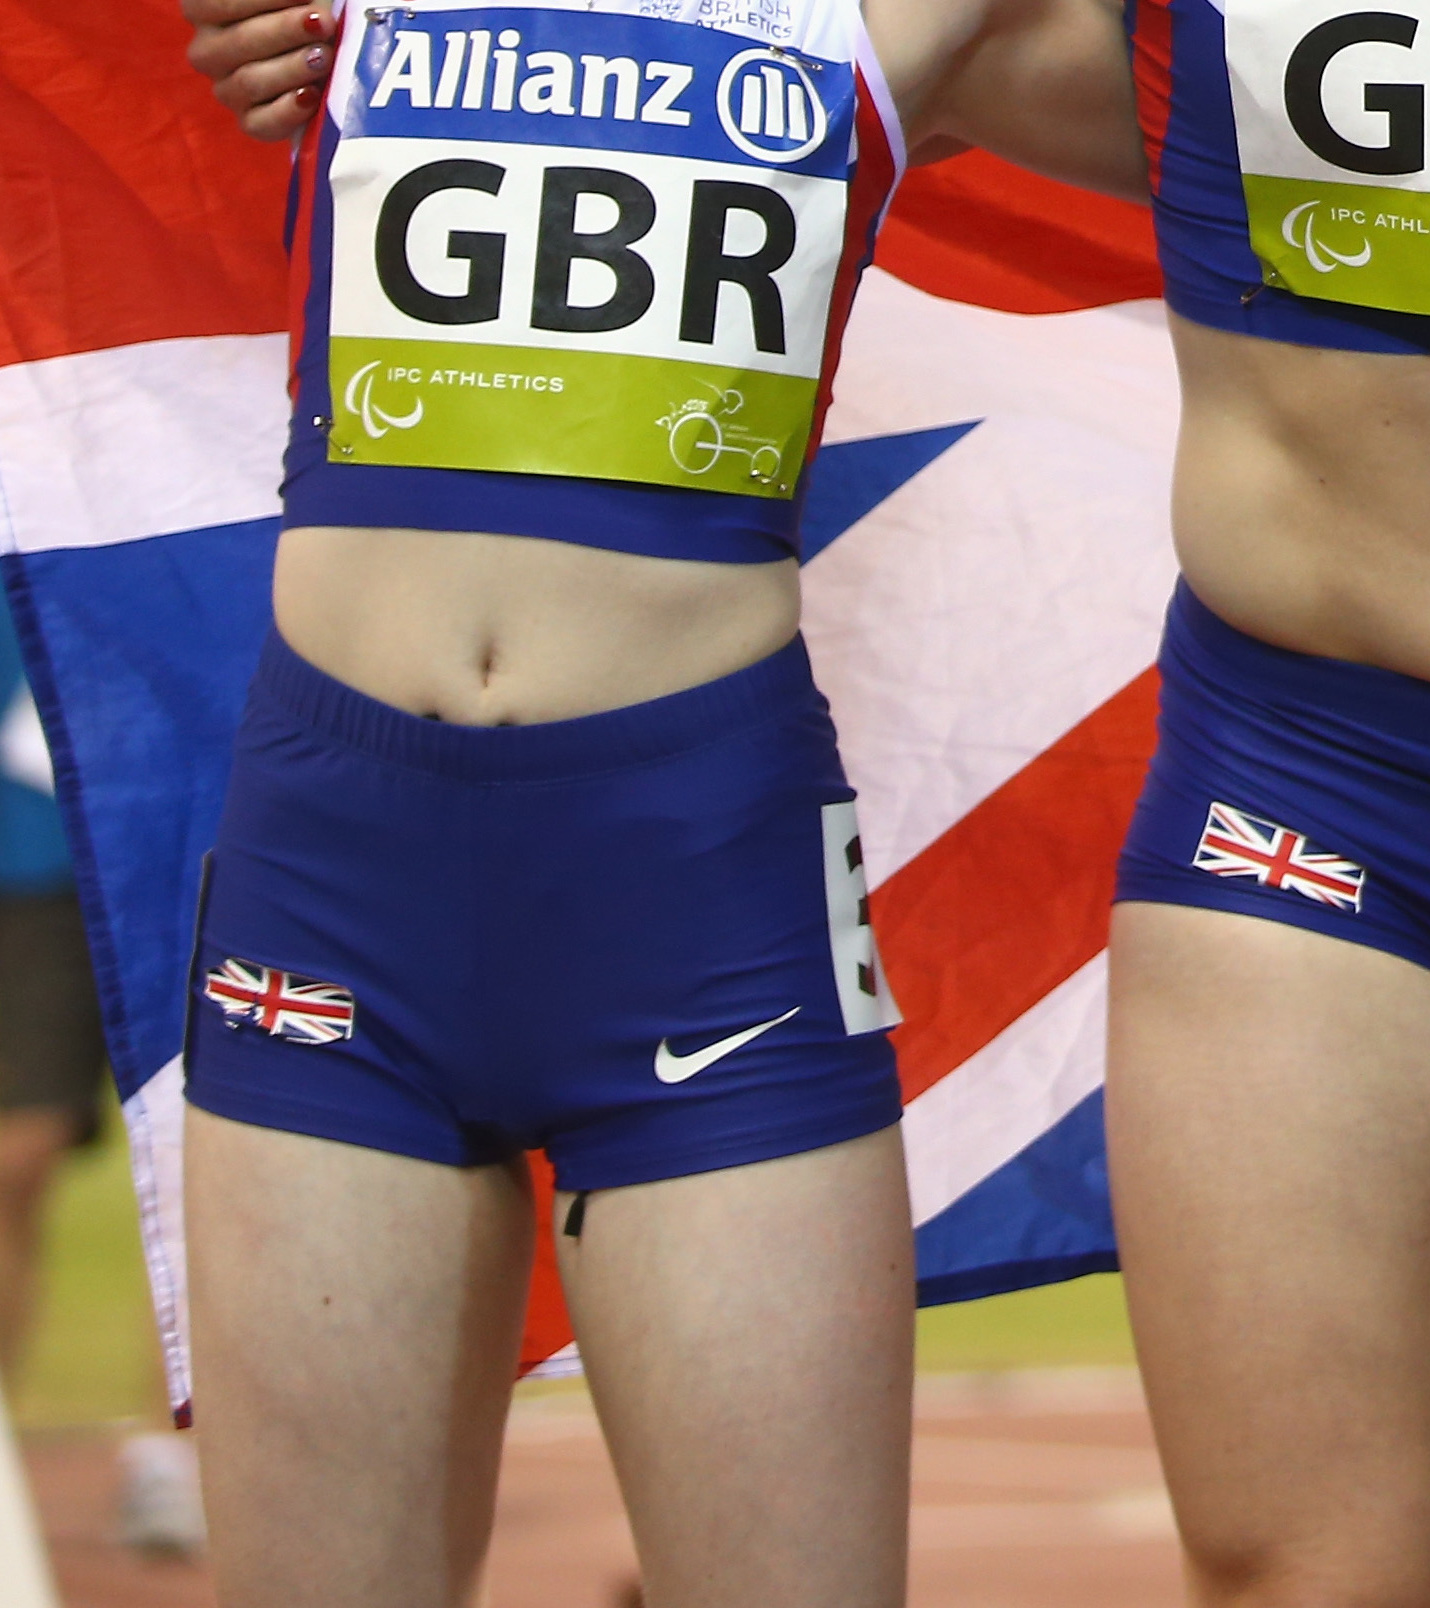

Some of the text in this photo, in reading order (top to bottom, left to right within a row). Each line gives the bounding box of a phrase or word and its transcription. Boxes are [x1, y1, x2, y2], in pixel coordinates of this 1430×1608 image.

[369, 28, 694, 128] Allianz
[1331, 208, 1366, 225] IPC
[374, 158, 797, 356] GBR
[387, 367, 565, 393] IPC ATHLETICS
